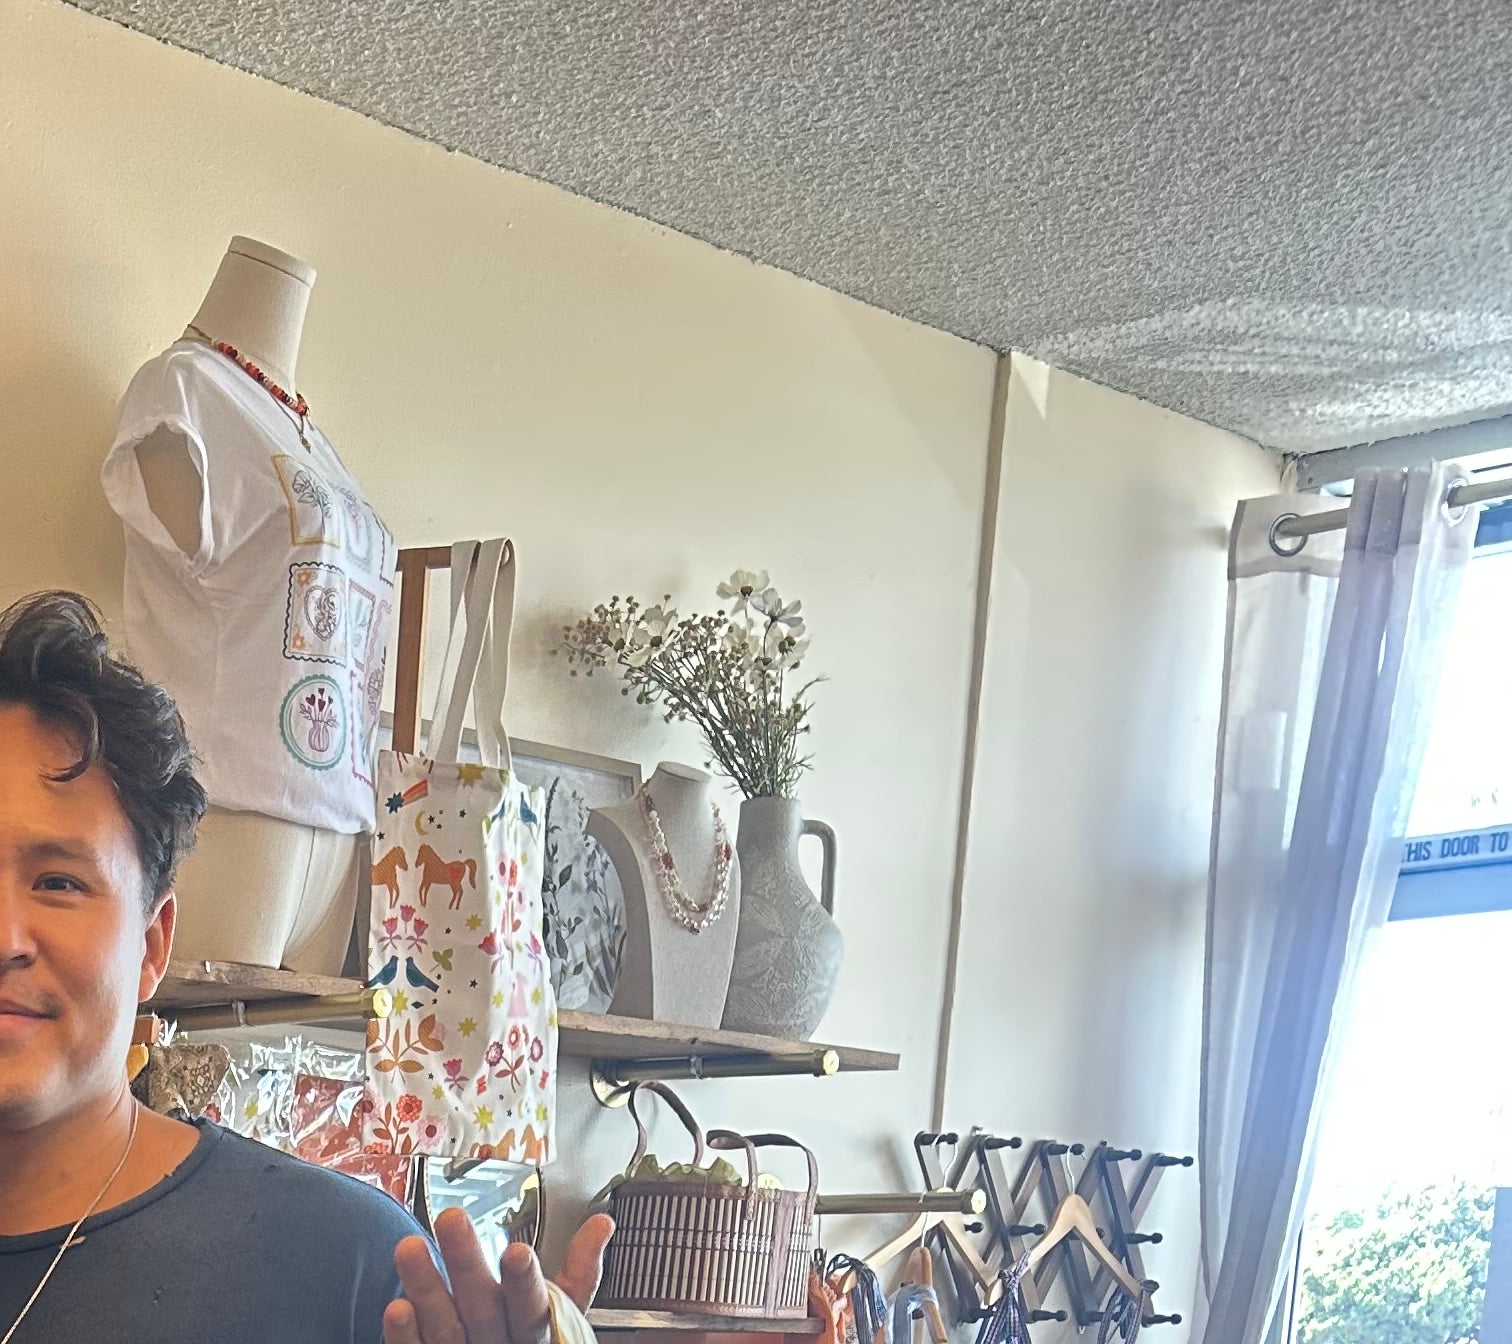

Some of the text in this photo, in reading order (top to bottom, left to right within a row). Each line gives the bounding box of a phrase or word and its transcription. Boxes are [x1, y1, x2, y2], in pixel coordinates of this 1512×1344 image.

[1402, 831, 1509, 863] HIS DOOR TO
